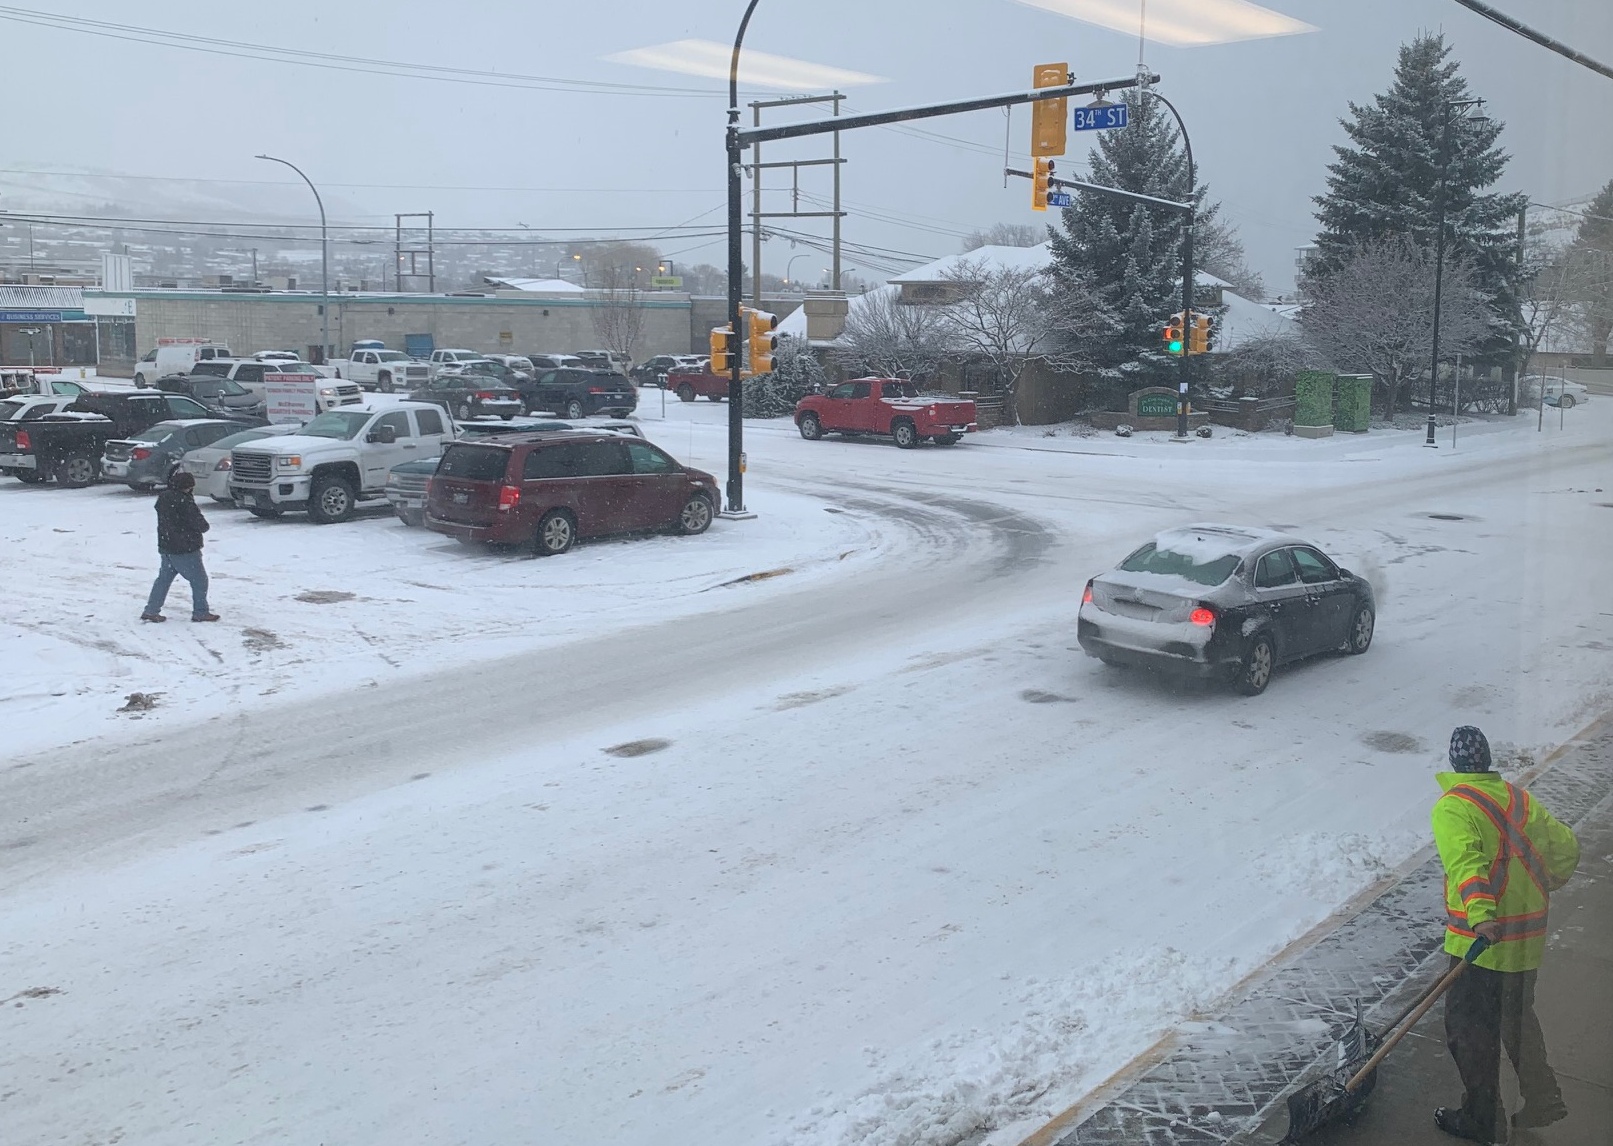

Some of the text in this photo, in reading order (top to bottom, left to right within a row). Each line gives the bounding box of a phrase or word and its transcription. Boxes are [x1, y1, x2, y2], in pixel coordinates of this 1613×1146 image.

[1076, 107, 1126, 129] 34TH ST
[1058, 195, 1070, 206] AVE
[6, 313, 60, 321] BUSINESS SERVICES
[1142, 405, 1173, 413] DENTIST
